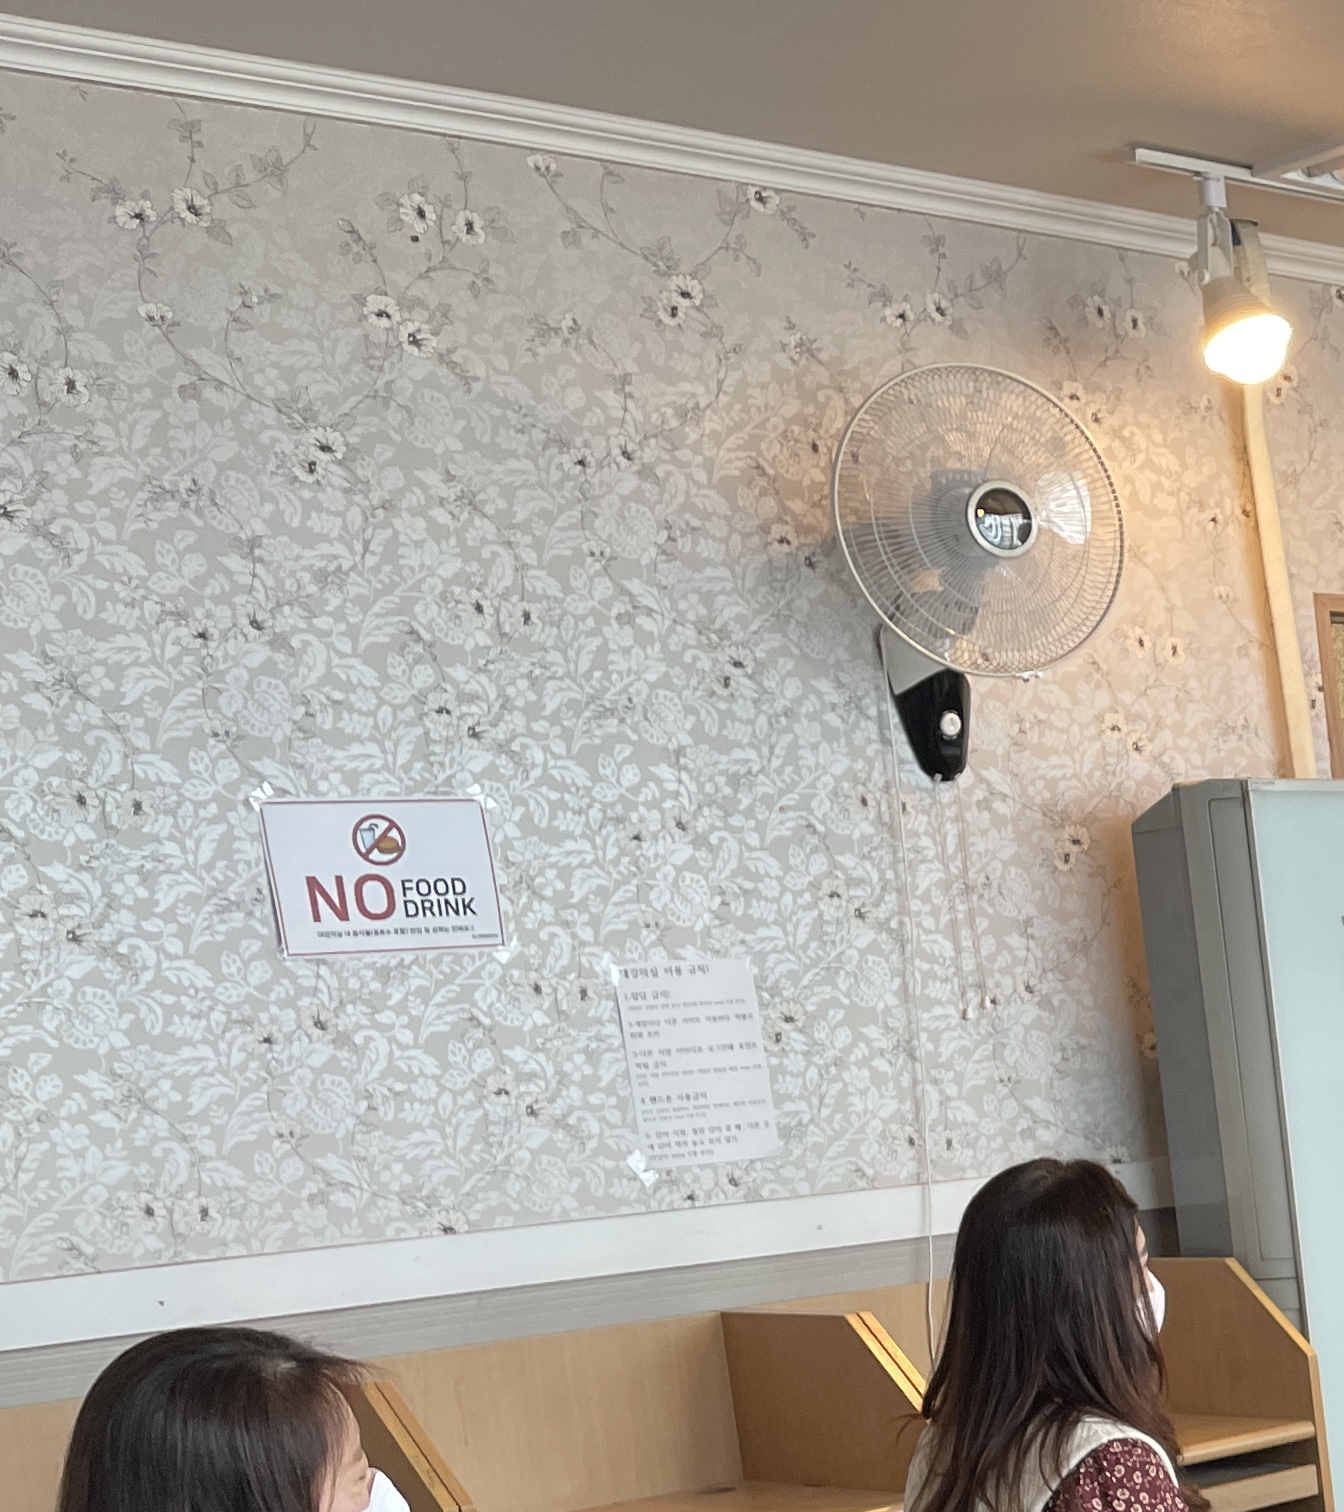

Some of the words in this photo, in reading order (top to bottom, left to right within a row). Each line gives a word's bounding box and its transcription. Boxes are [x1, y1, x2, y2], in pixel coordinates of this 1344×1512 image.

[306, 873, 396, 923] NO
[401, 877, 467, 897] FOOD
[403, 897, 478, 918] DRINK
